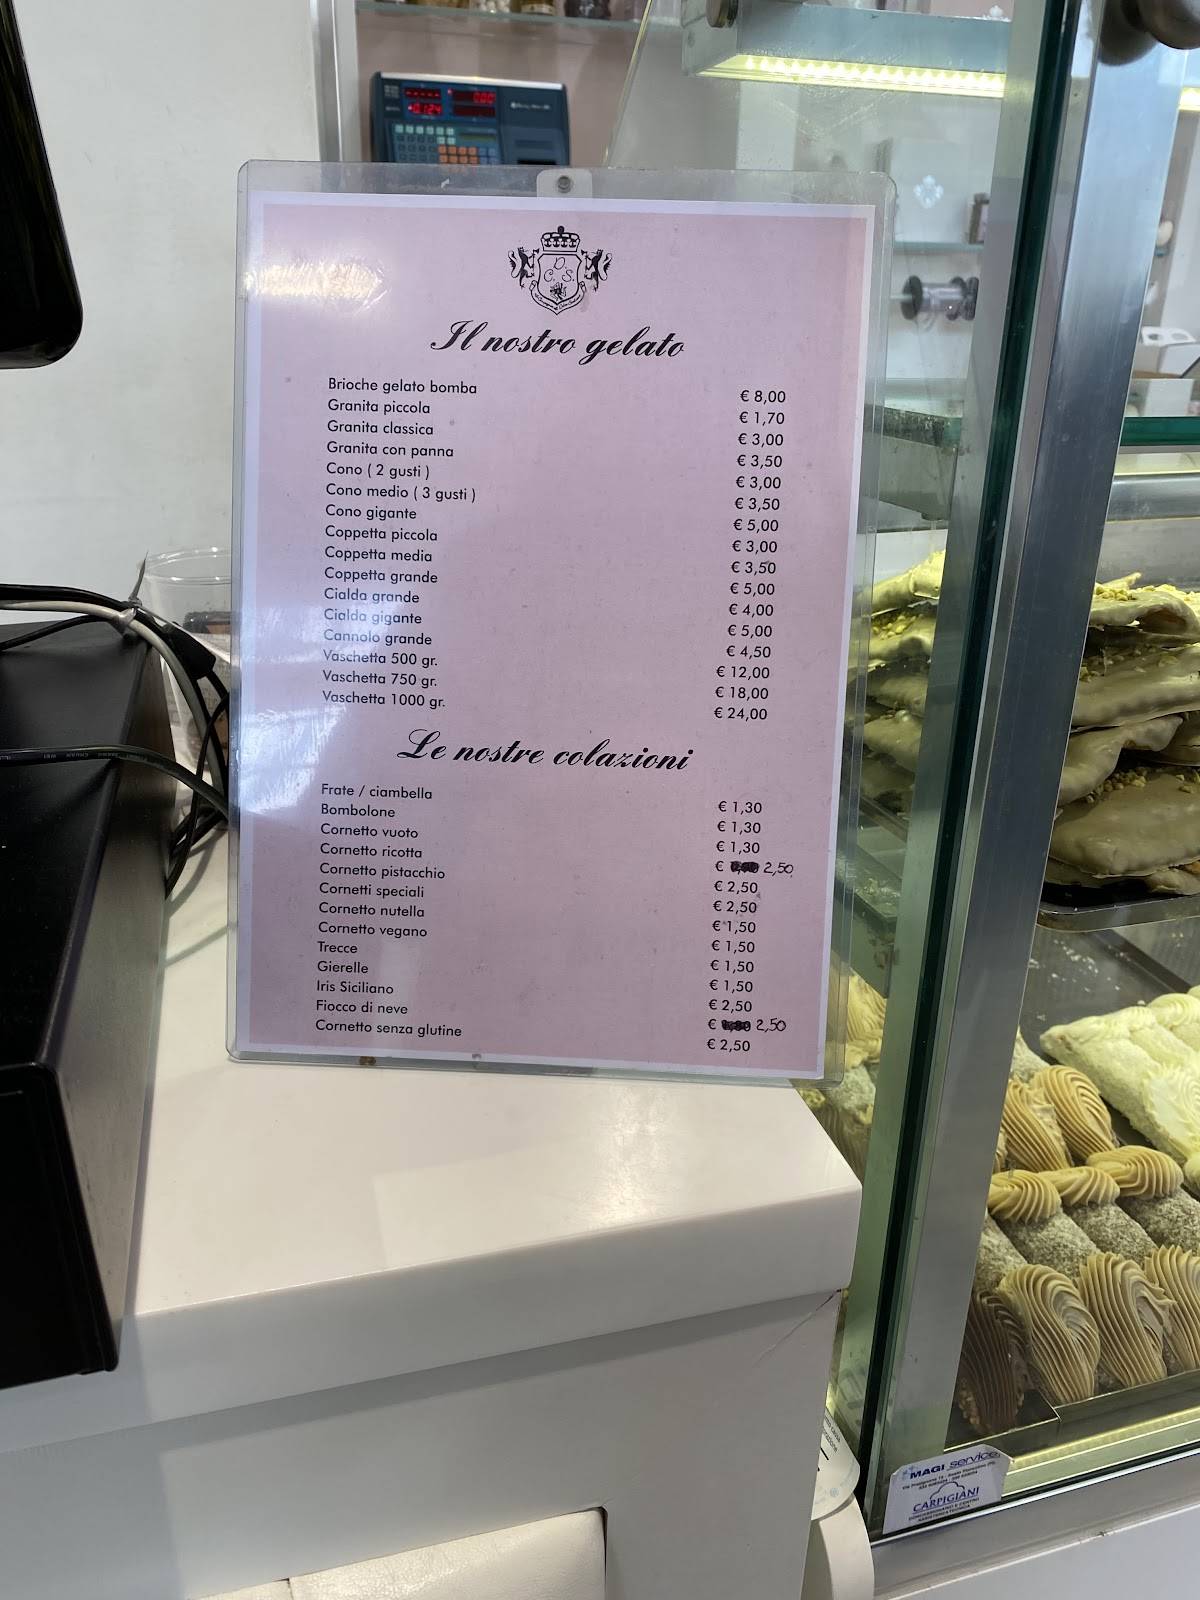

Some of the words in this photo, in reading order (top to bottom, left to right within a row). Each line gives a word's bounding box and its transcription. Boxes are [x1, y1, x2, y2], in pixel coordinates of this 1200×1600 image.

[430, 319, 489, 352] Il
[481, 329, 576, 354] nostro
[578, 326, 685, 366] gelato
[328, 377, 378, 391] Brioche
[382, 379, 425, 395] gelato
[430, 380, 477, 394] bomba
[740, 389, 750, 402] €
[754, 390, 786, 405] 8,00
[327, 398, 379, 412] Granita
[383, 400, 430, 415] piccola
[739, 411, 748, 424] €
[754, 412, 785, 426] 1,70
[327, 419, 378, 434] Granita
[383, 421, 434, 435] classica
[738, 433, 747, 445] €
[752, 433, 784, 448] 3,00
[326, 440, 378, 455] Granita
[382, 445, 406, 456] con
[411, 446, 454, 459] panna
[737, 454, 746, 467] €
[750, 455, 783, 469] 3,50
[326, 462, 363, 475] Cono
[376, 464, 384, 476] 2
[389, 465, 421, 480] gusti
[736, 476, 745, 488] €
[749, 476, 782, 491] 3,00
[326, 483, 362, 496] Cono
[367, 485, 409, 498] medio
[422, 486, 430, 499] 3
[435, 488, 467, 503] gusti
[325, 504, 362, 517] Cono
[366, 505, 417, 521] gigante
[735, 497, 744, 510] €
[748, 498, 780, 512] 3,50
[325, 524, 386, 541] Coppetta
[391, 528, 438, 542] piccola
[733, 518, 743, 531] €
[747, 519, 779, 534] 5,00
[325, 545, 386, 562] Coppetta
[391, 549, 432, 562] media
[732, 540, 741, 552] €
[745, 540, 778, 555] 3,00
[324, 566, 386, 582] Coppetta
[390, 570, 438, 584] grande
[731, 561, 740, 573] €
[744, 561, 776, 576] 3,50
[324, 587, 367, 601] Cialda
[372, 591, 420, 604] grande
[730, 582, 739, 595] €
[743, 583, 775, 597] 5,00
[324, 608, 367, 622] Cialda
[371, 610, 422, 626] gigante
[729, 603, 738, 615] €
[742, 604, 774, 618] 4,00
[323, 629, 380, 643] Cannolo
[385, 632, 432, 646] grande
[727, 624, 737, 636] €
[741, 625, 773, 639] 5,00
[323, 649, 386, 664] Vaschetta
[391, 652, 417, 665] 500
[421, 657, 438, 669] gr.
[726, 645, 736, 657] €
[740, 645, 771, 660] 4,50
[322, 670, 386, 684] Vaschetta
[391, 673, 417, 686] 750
[421, 677, 437, 689] gr.
[716, 666, 725, 678] €
[731, 666, 770, 680] 12,00
[322, 690, 386, 705] Vaschetta
[391, 693, 425, 706] 1000
[429, 697, 445, 710] gr.
[715, 686, 724, 698] €
[730, 687, 769, 701] 18,00
[714, 707, 723, 719] €
[727, 707, 768, 722] 24,00
[396, 728, 447, 760] Le
[452, 740, 545, 765] nostre
[552, 739, 694, 770] colazioni
[321, 783, 355, 796] Frate
[369, 785, 433, 800] ciambella
[321, 803, 395, 818] Bombolone
[718, 800, 727, 813] €
[733, 801, 763, 815] 1,30
[320, 823, 378, 837] Cornetto
[382, 827, 419, 839] vuoto
[717, 820, 726, 832] €
[731, 821, 762, 836] 1,30
[320, 842, 378, 857] Cornetto
[382, 845, 422, 858] ricotta
[716, 840, 725, 852] €
[730, 841, 760, 855] 1,30
[320, 862, 377, 876] Cornetto
[381, 865, 445, 880] pistacchio
[715, 860, 724, 872] €
[763, 861, 794, 877] 2,50
[319, 882, 372, 896] Cornetti
[376, 885, 424, 899] speciali
[714, 880, 723, 892] €
[727, 881, 758, 895] 2,50
[319, 901, 376, 916] Cornetto
[380, 905, 425, 918] nutella
[713, 900, 722, 912] €
[726, 900, 757, 915] 2,50
[318, 921, 375, 935] Cornetto
[380, 927, 428, 939] vegano
[712, 920, 721, 932] €
[727, 920, 756, 935] 1,50
[317, 941, 358, 954] Trecce
[711, 940, 720, 951] €
[726, 940, 755, 954] 1,50
[317, 960, 369, 974] Gierelle
[710, 959, 720, 971] €
[725, 960, 754, 974] 1,50
[316, 980, 335, 992] Iris
[340, 981, 394, 995] Siciliano
[709, 979, 719, 991] €
[724, 980, 753, 994] 1,50
[316, 1000, 356, 1013] Fiocco
[361, 1001, 373, 1013] di
[377, 1004, 408, 1015] neve
[709, 999, 718, 1010] €
[721, 999, 752, 1014] 2,50
[315, 1019, 372, 1033] Cornetto
[376, 1023, 413, 1035] senza
[417, 1024, 462, 1038] glutine
[707, 1018, 717, 1030] €
[756, 1017, 787, 1033] 2,50
[707, 1038, 716, 1050] €
[720, 1039, 751, 1053] 2,50
[910, 1464, 945, 1479] MAGI
[949, 1451, 998, 1469] service
[913, 1486, 979, 1512] CARPIGIANI
